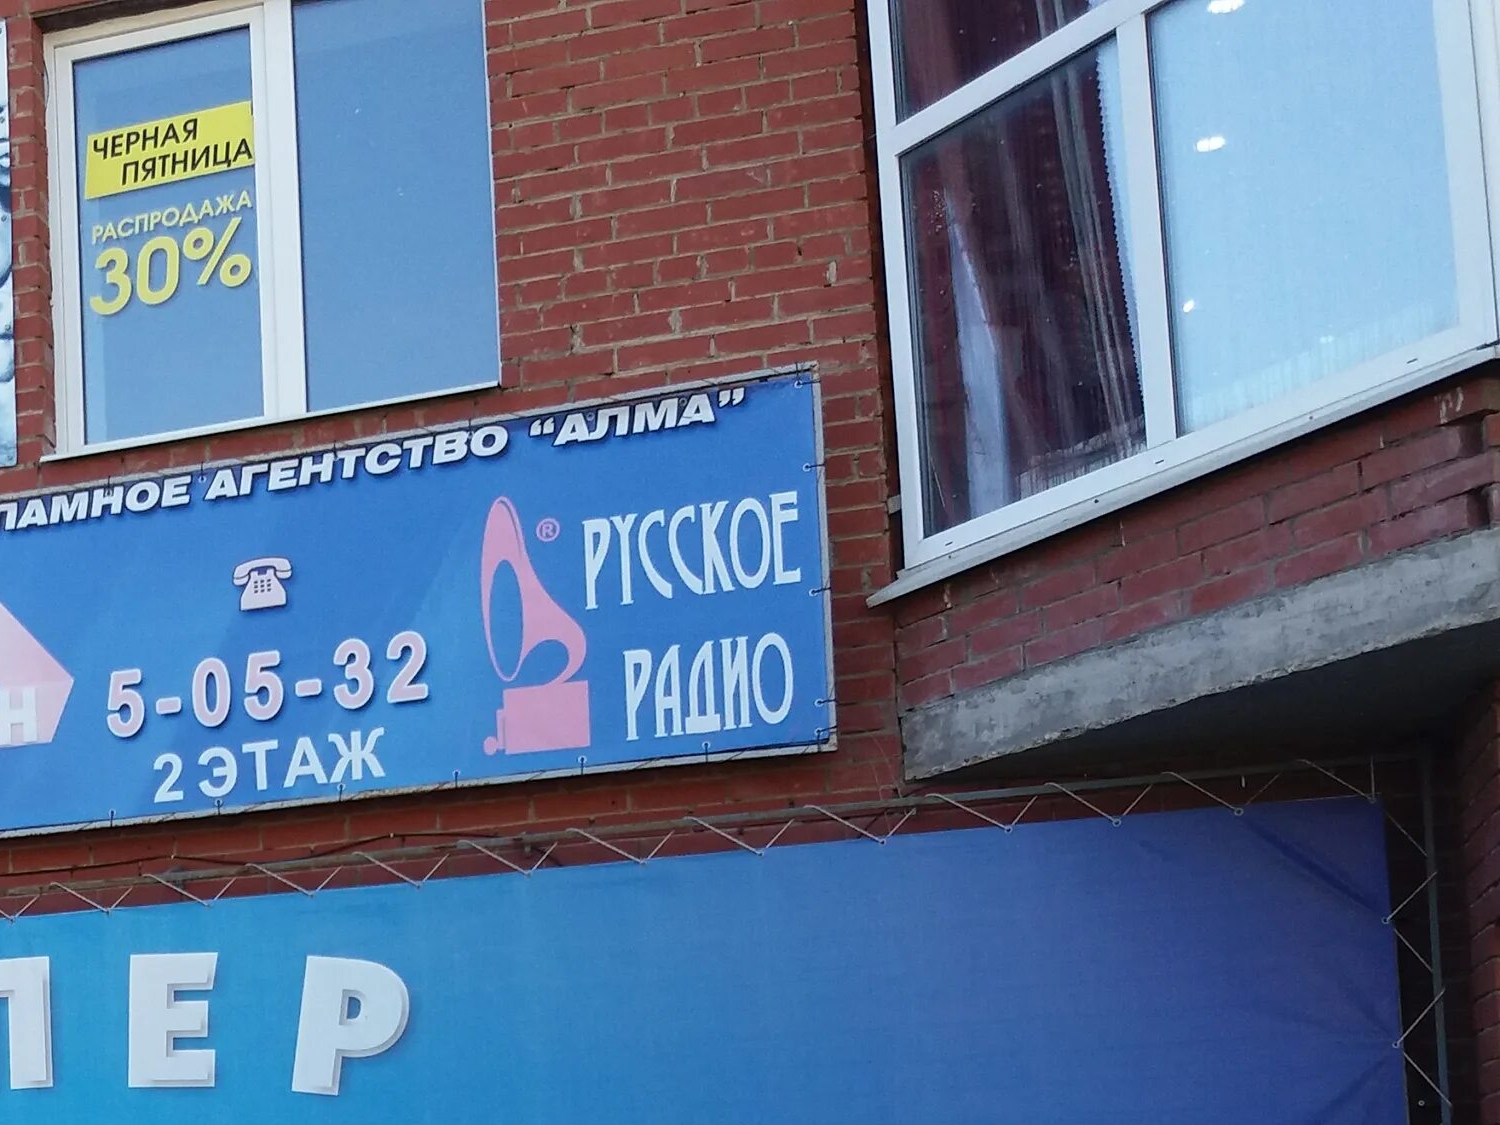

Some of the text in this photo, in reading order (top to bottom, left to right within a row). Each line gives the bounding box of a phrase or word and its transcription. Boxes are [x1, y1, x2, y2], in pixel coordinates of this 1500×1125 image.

[93, 118, 198, 160] ЧЕРНАЯ
[122, 138, 253, 186] ПЯТНИЦА
[92, 190, 252, 245] РАСПРОДАЖА
[90, 217, 252, 316] 30%
[205, 426, 509, 502] АГЕНТСТВО
[582, 490, 801, 610] РУССКОЕ
[106, 630, 429, 738] 5-05-32
[622, 632, 794, 741] РАДИО
[153, 727, 386, 803] 2 ЭТАЖ
